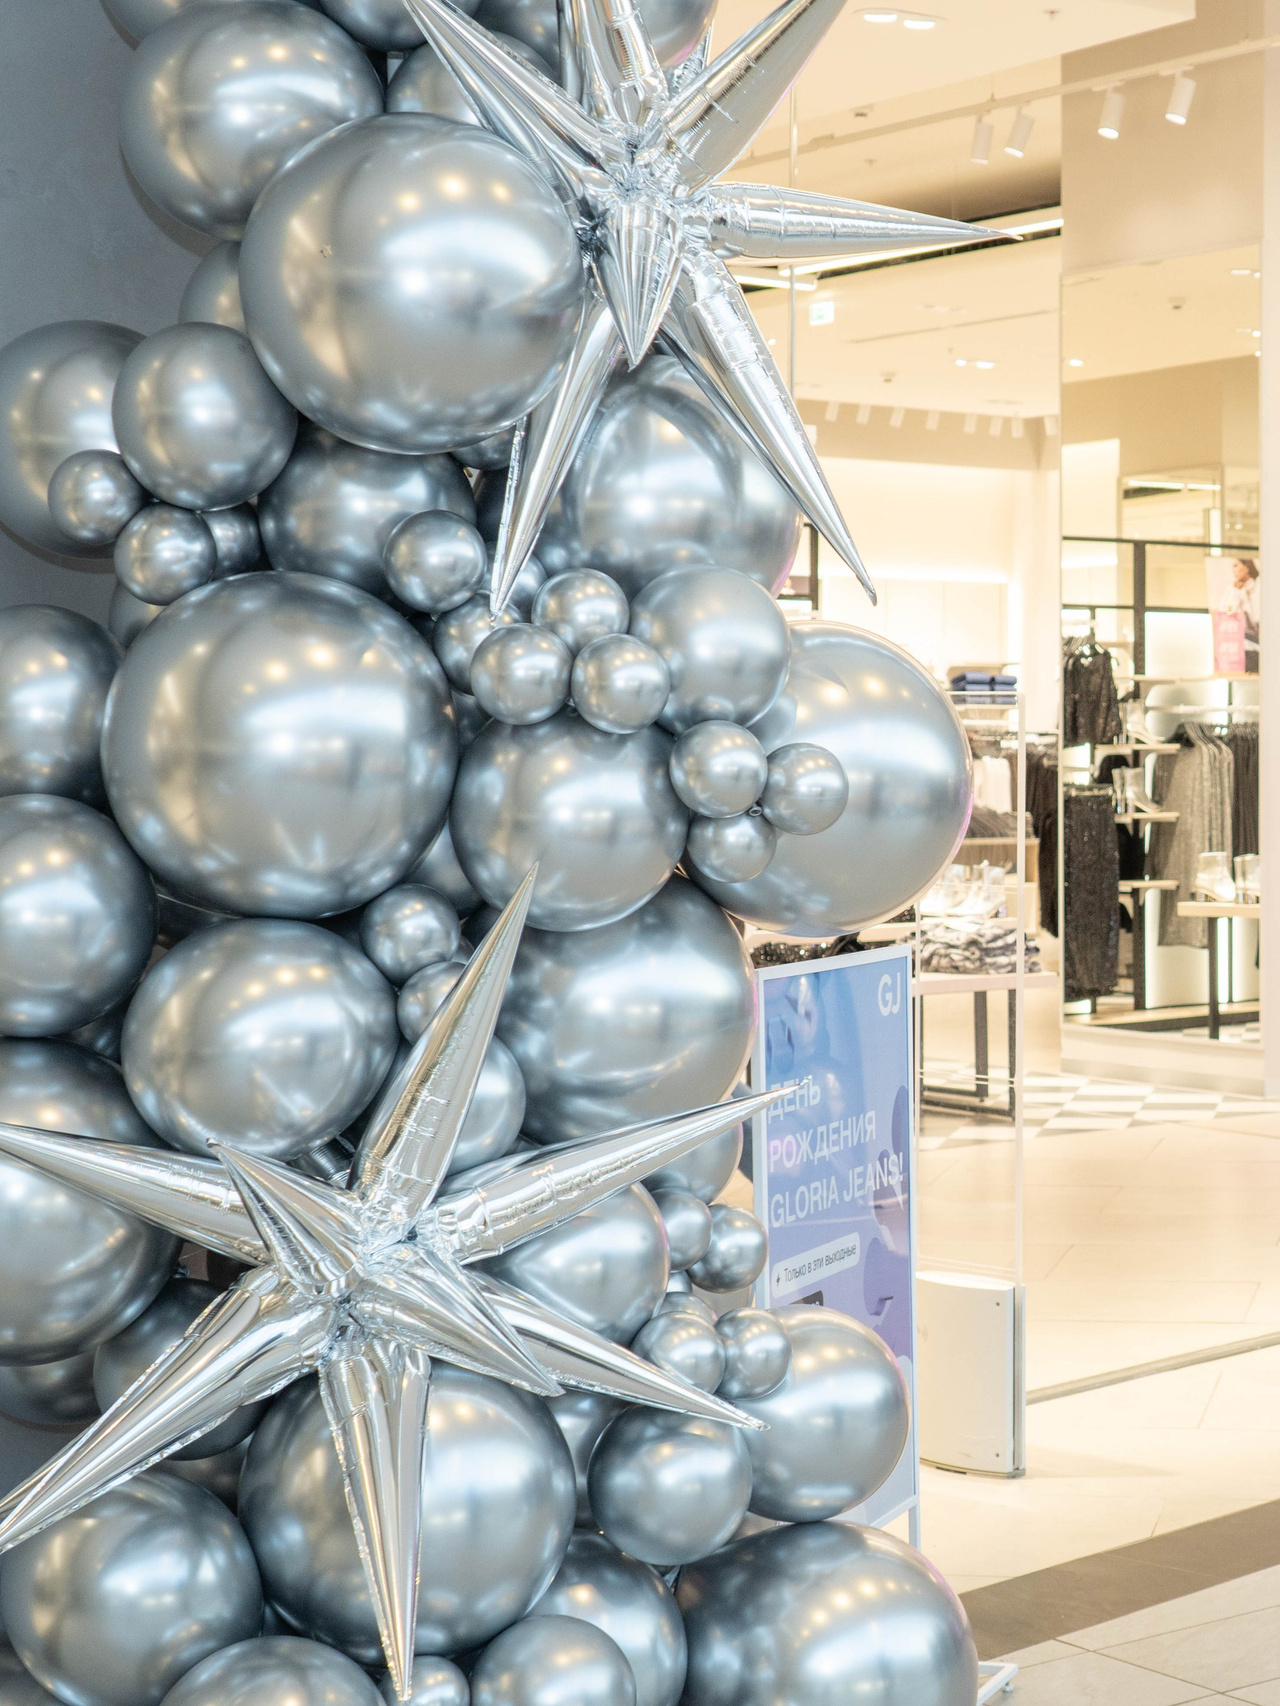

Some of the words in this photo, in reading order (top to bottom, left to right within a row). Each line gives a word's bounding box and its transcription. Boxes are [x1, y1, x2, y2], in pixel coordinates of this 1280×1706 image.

[877, 971, 902, 1017] GJ
[767, 1076, 822, 1125] ДЕНЬ
[768, 1110, 877, 1174] РОЖДЕНИЯ
[769, 1175, 840, 1229] GLORIA
[842, 1151, 904, 1203] JEANS!
[783, 1263, 807, 1283] Только
[807, 1262, 812, 1273] в
[812, 1257, 824, 1272] эти
[825, 1244, 857, 1267] выходные
